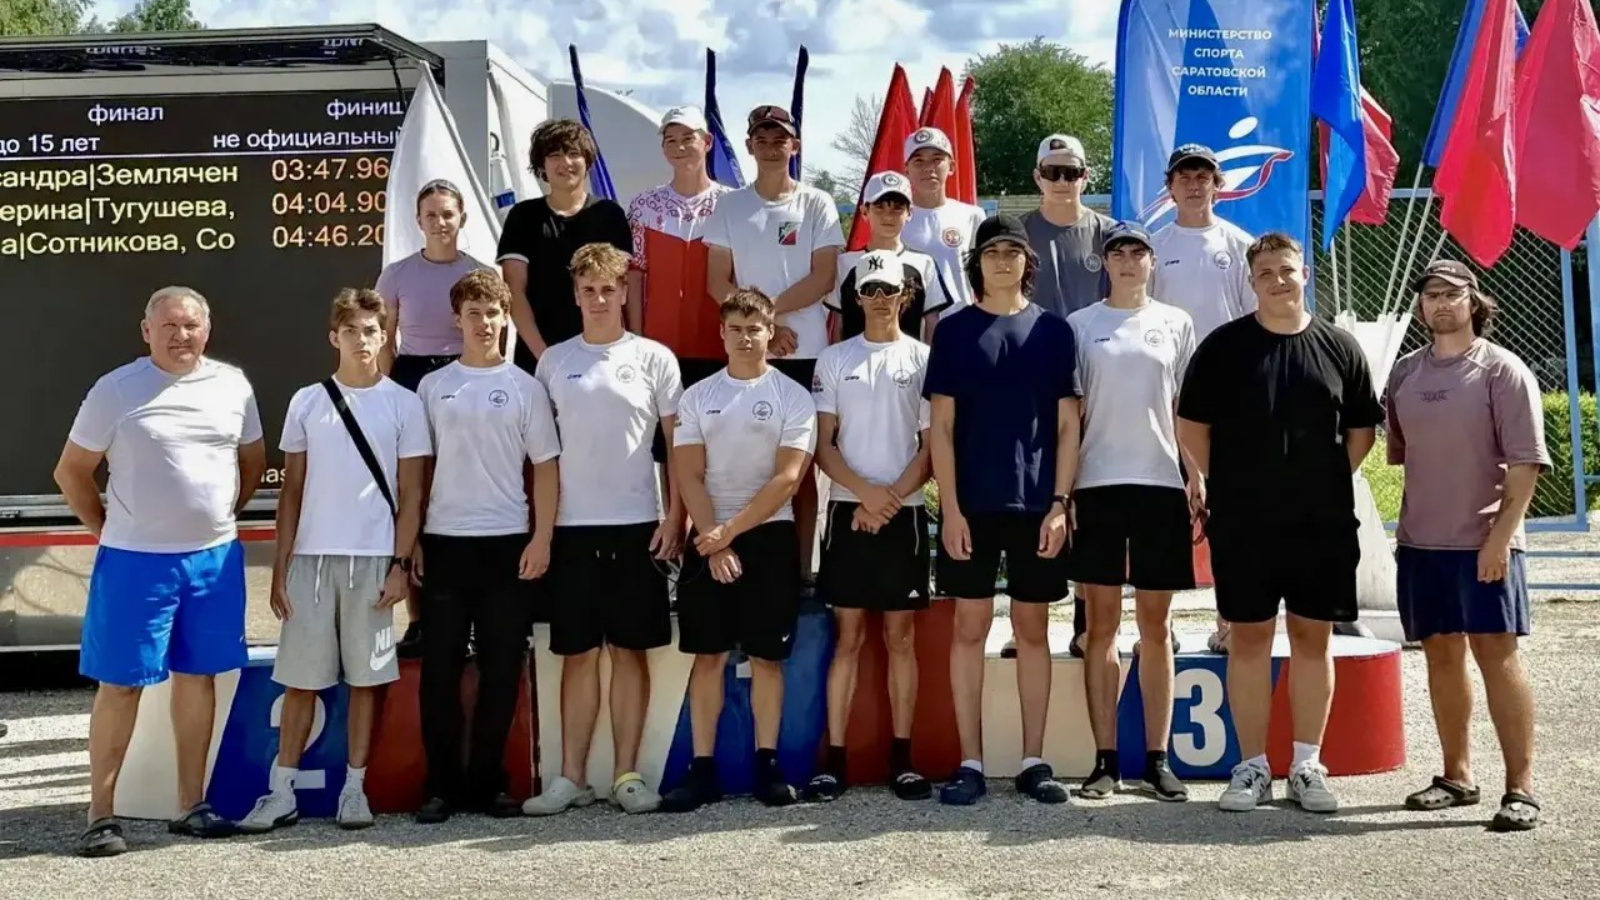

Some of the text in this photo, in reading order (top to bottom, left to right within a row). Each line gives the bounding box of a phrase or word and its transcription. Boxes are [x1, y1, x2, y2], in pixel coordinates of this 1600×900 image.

[1168, 28, 1272, 40] МИНИСТЕРСТВО
[1193, 47, 1245, 59] СПОРТА
[1171, 65, 1267, 78] САРАТОВСКОЙ
[1187, 84, 1249, 96] ОБЛАСТИ
[87, 103, 164, 126] финал
[28, 134, 55, 153] 15
[59, 137, 101, 153] лет
[213, 133, 241, 149] не
[0, 163, 238, 192] андра|Землячен
[271, 156, 389, 182] 03:47.96
[271, 190, 387, 215] 04:04.90
[195, 227, 236, 250] Со
[374, 626, 395, 654] NI
[1172, 668, 1226, 767] 3
